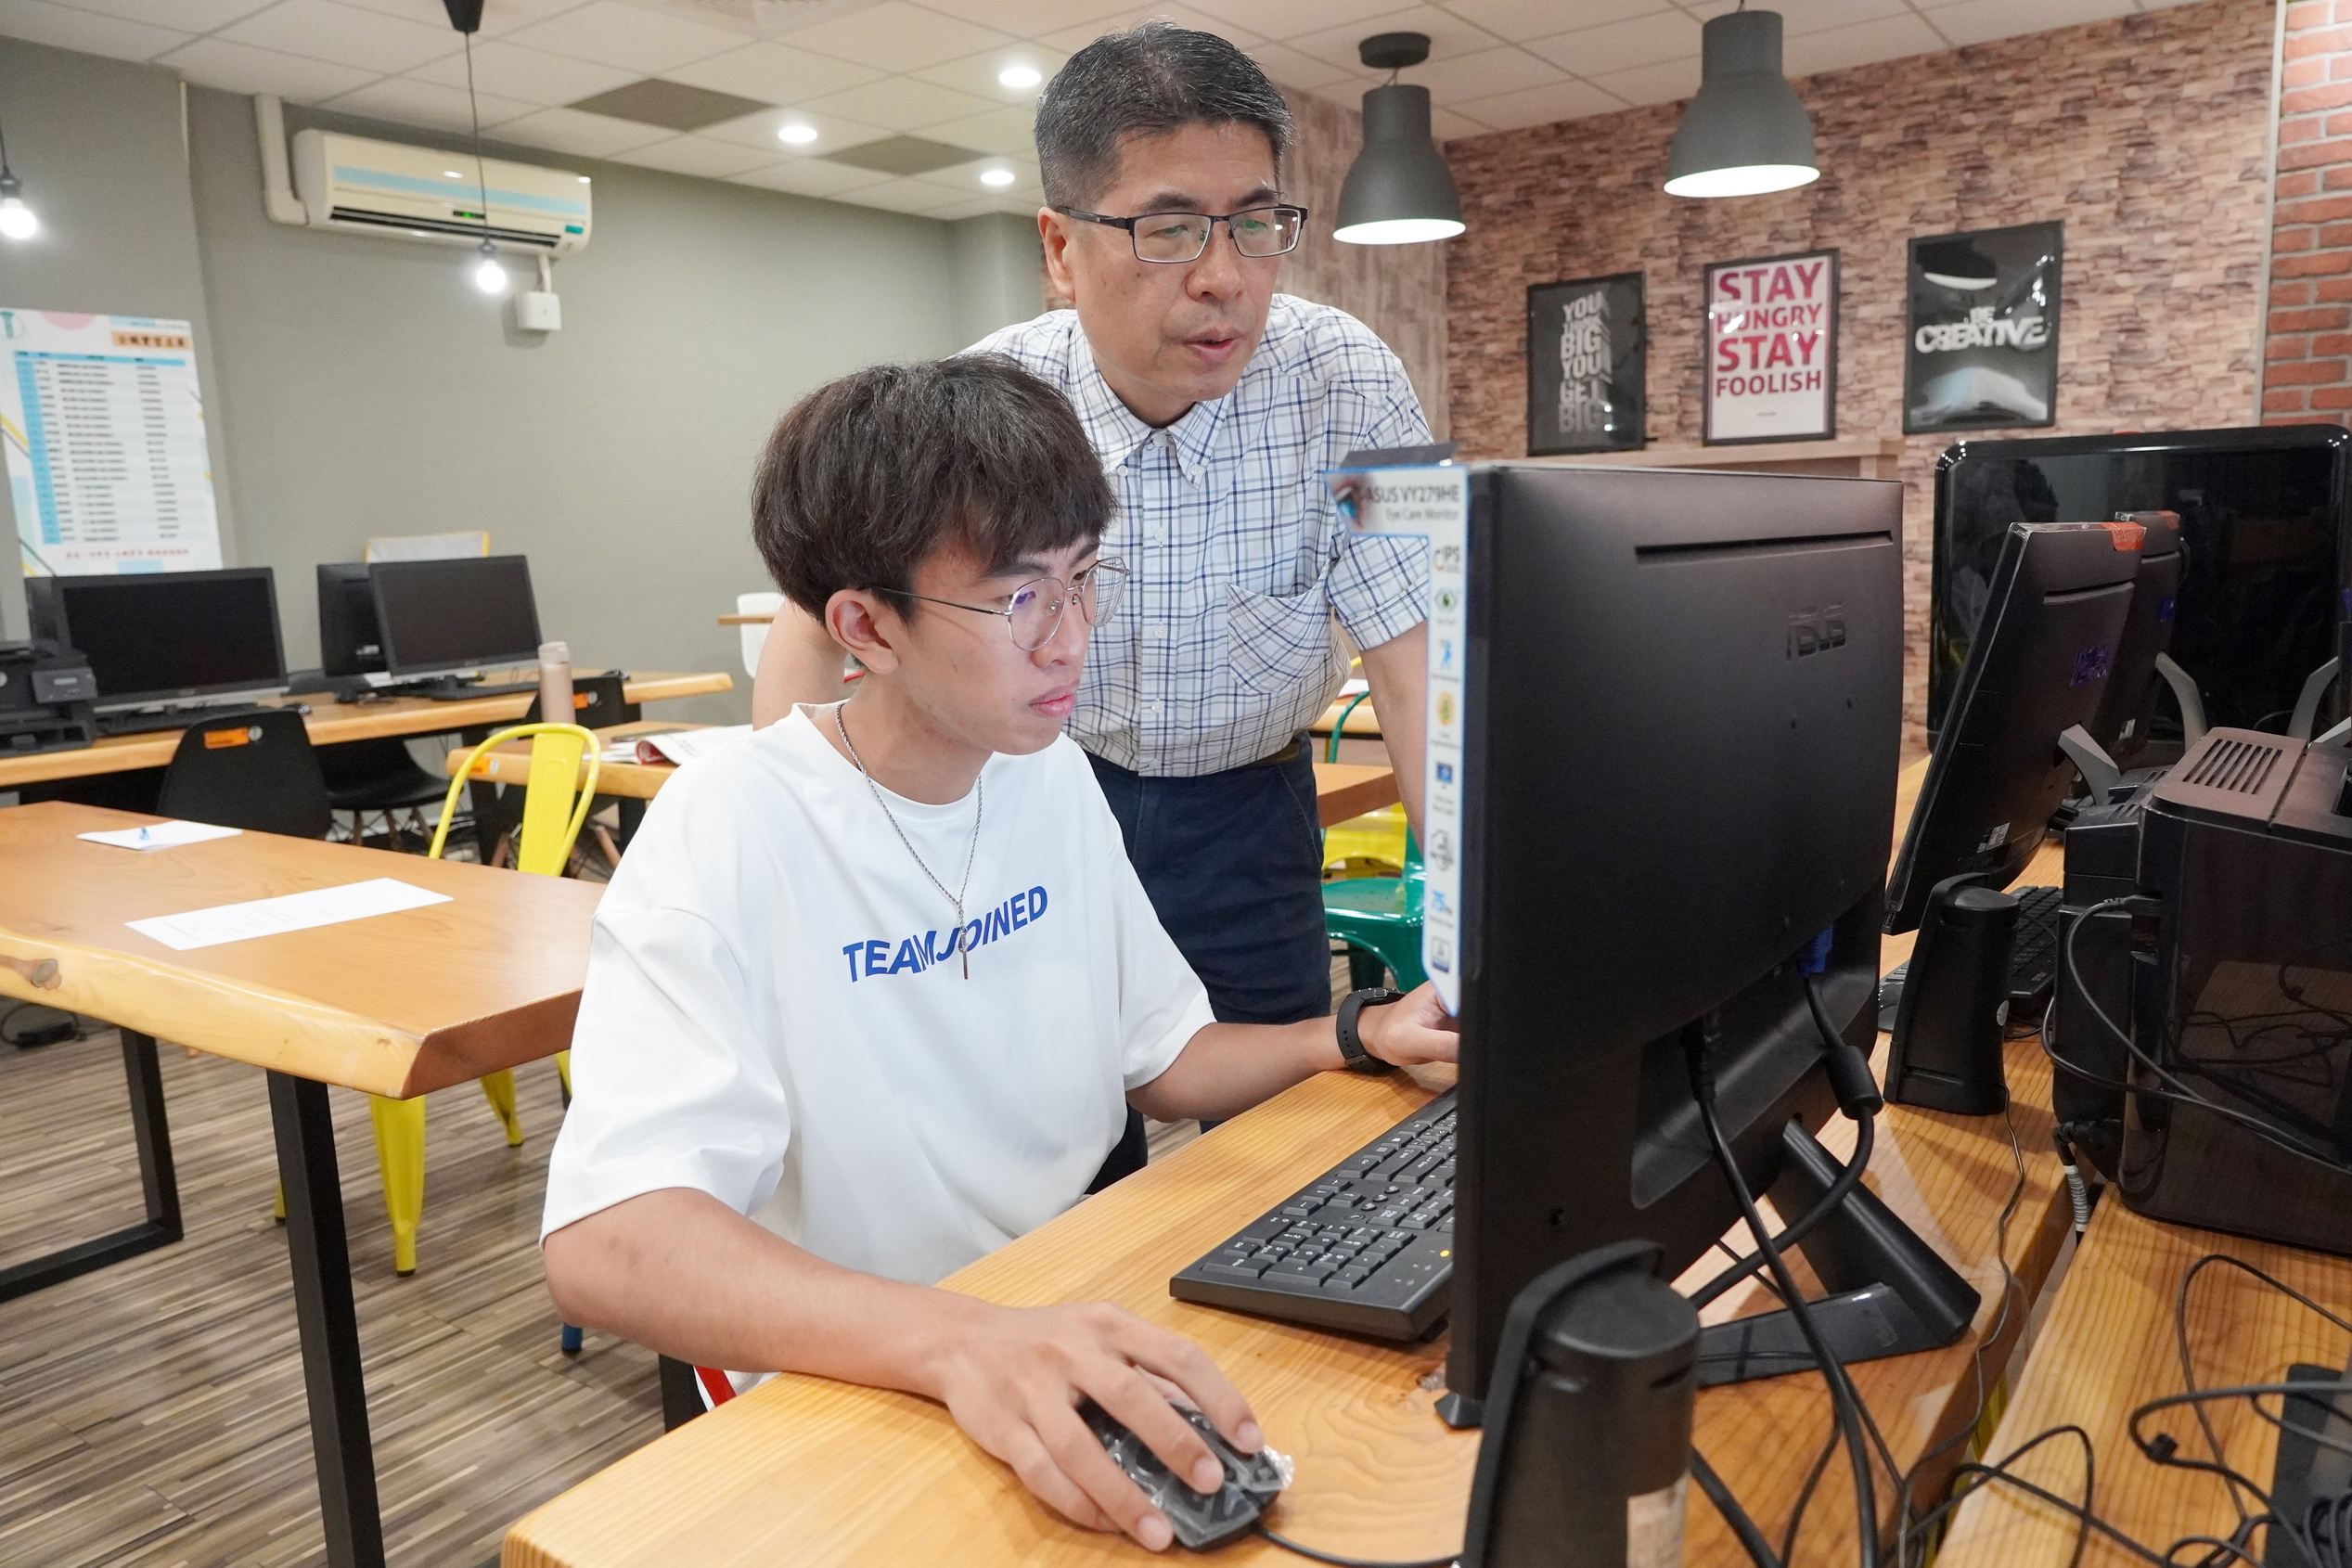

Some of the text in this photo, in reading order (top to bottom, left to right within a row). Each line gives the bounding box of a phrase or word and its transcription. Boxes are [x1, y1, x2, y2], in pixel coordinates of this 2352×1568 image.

[1718, 262, 1824, 304] STAY
[1562, 290, 1603, 321] YOU
[1716, 303, 1823, 334] HUNGRY
[1560, 325, 1602, 360] BIG
[1716, 330, 1824, 372] STAY
[1914, 315, 2048, 354] CREATIVE
[1562, 353, 1602, 380] YOU
[1715, 370, 1821, 398] FOOLISH
[1366, 486, 1398, 504] ASUS
[842, 885, 1048, 983] TEAM JOINED
